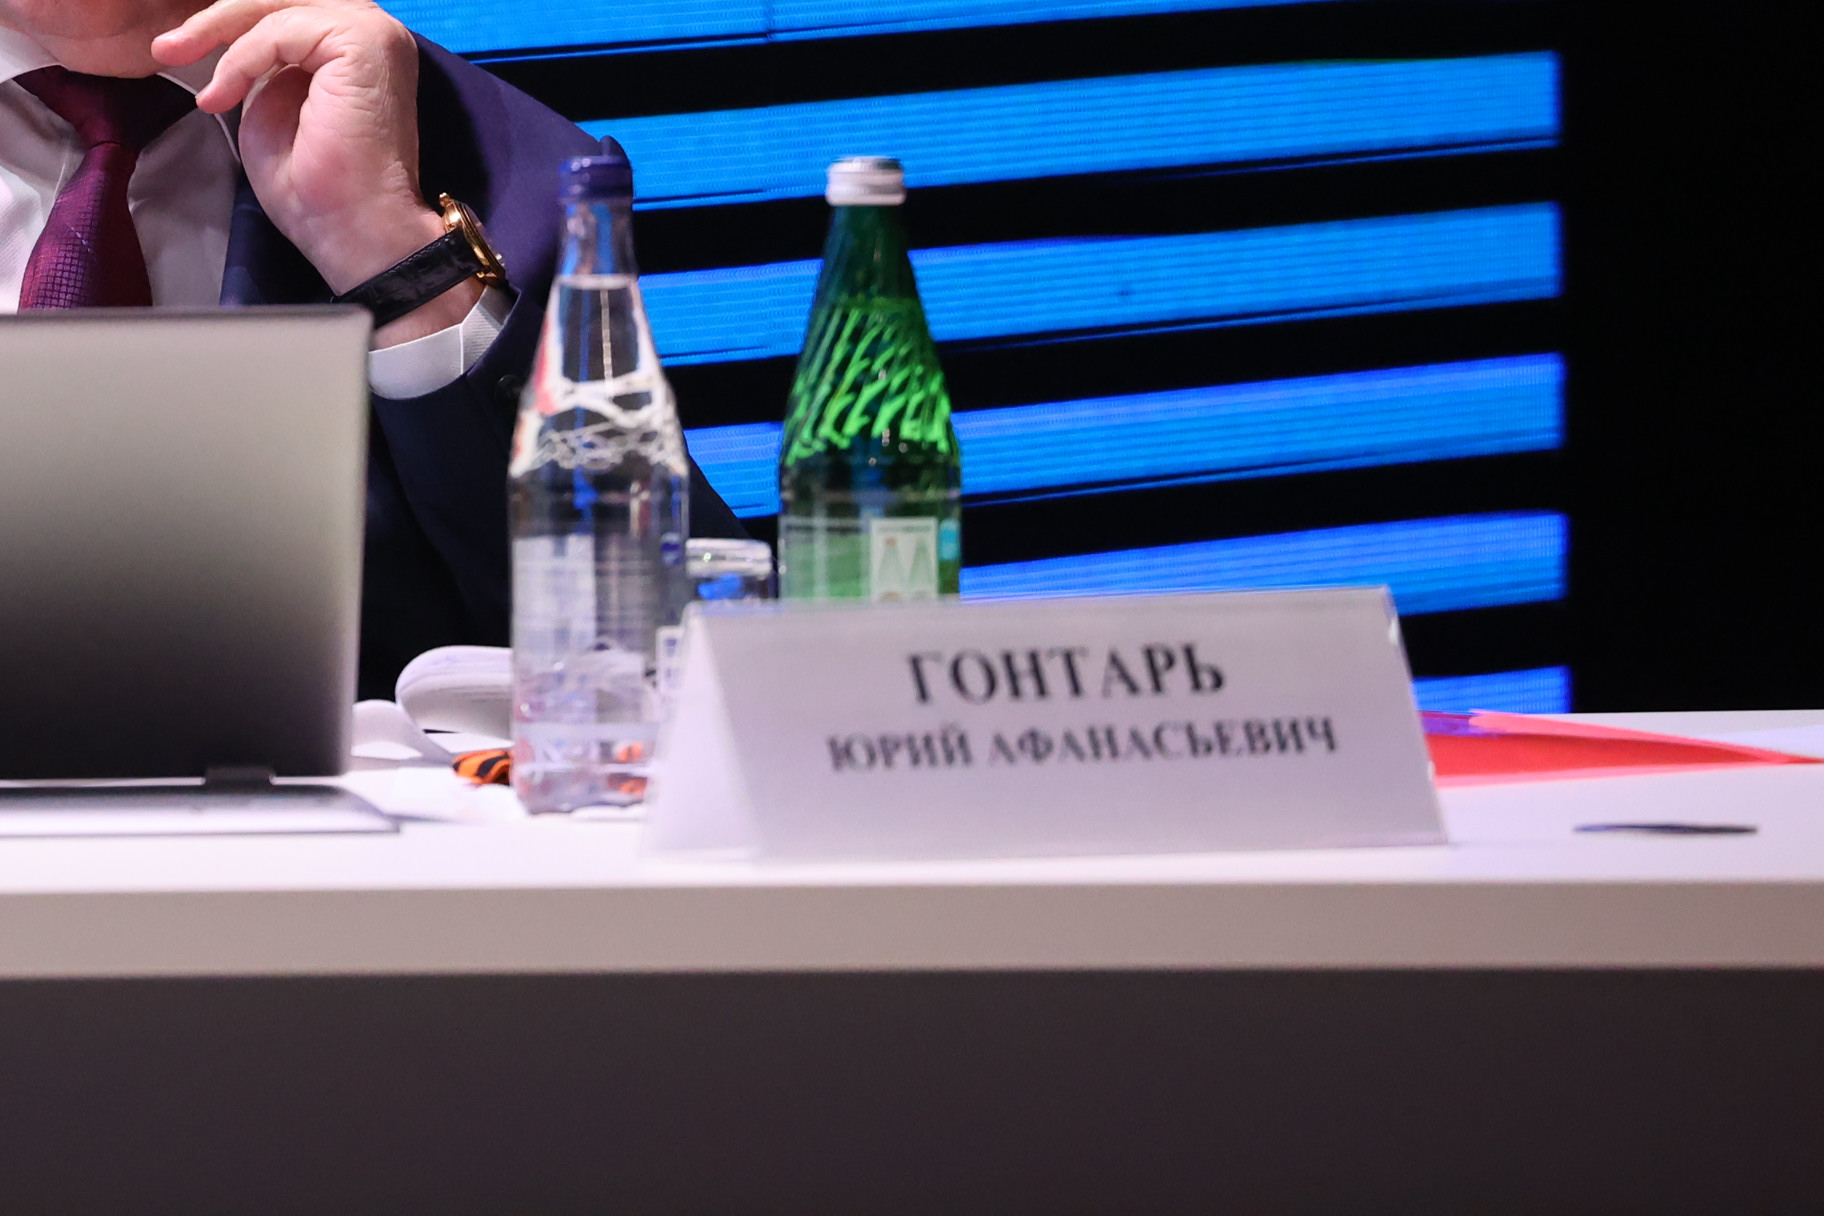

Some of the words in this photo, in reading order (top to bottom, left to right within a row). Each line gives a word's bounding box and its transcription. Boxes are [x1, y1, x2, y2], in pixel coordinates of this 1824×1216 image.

[907, 642, 1225, 704] ГОНТАРЬ
[827, 721, 973, 772] ЮРИЙ
[989, 717, 1337, 766] АФАНАСЬЕВИЧ
